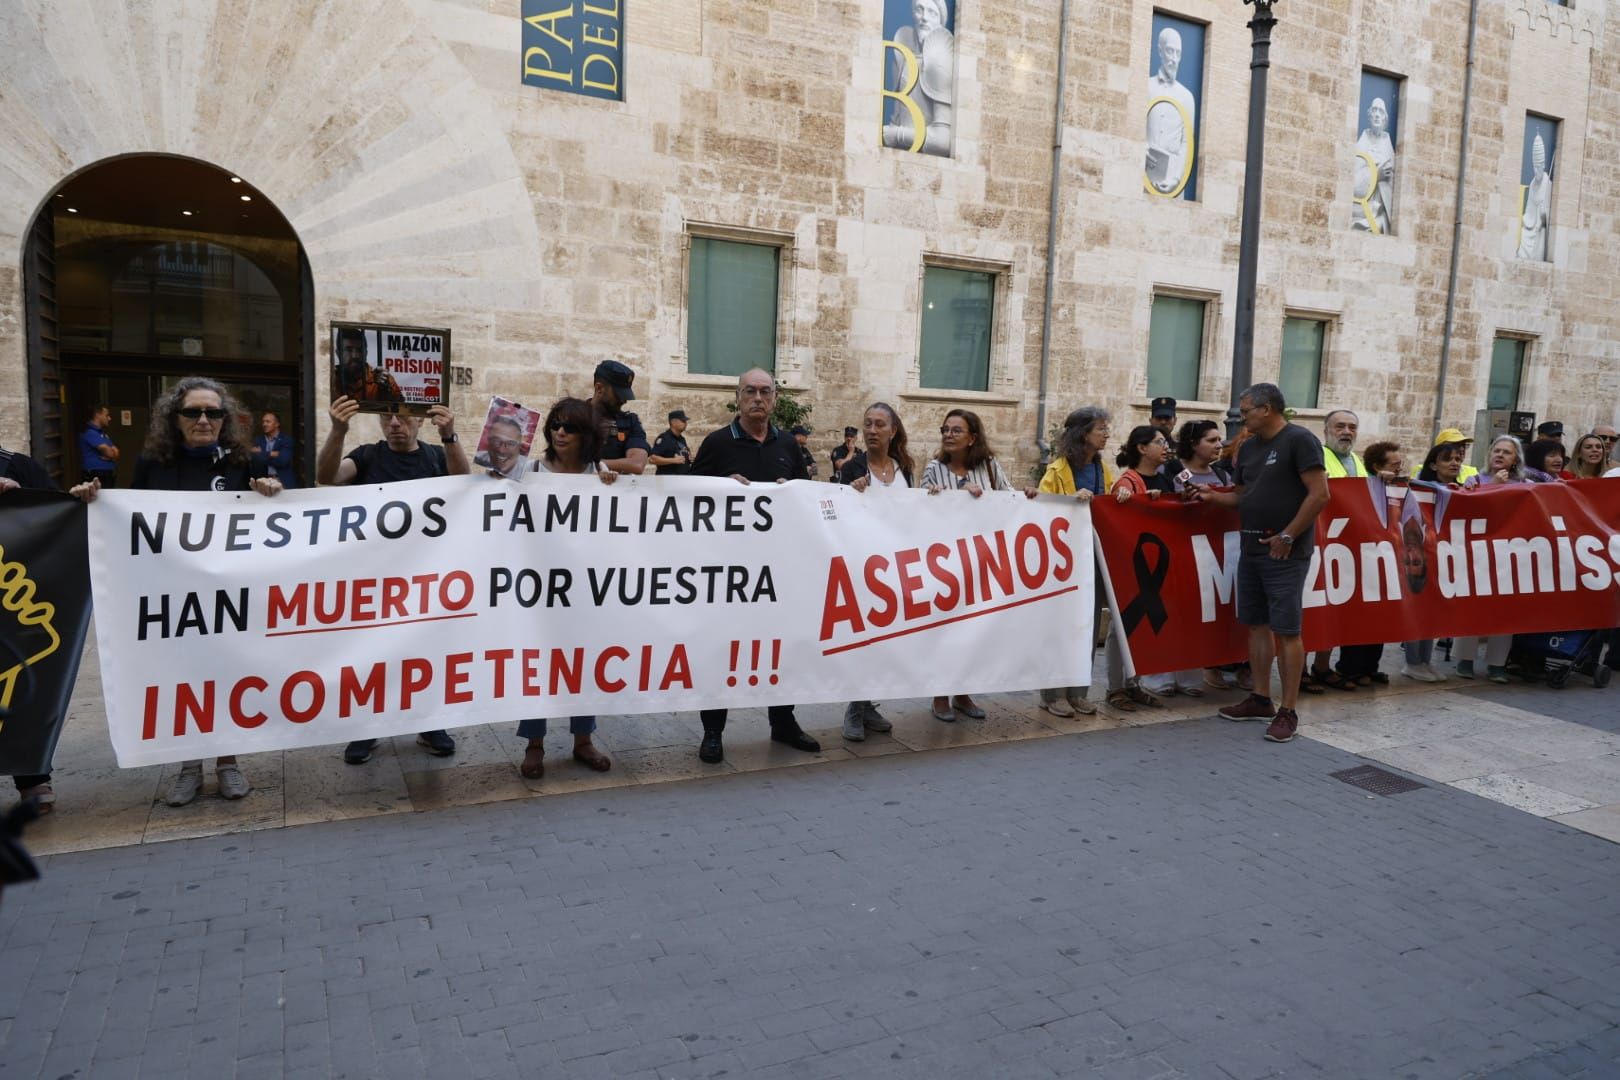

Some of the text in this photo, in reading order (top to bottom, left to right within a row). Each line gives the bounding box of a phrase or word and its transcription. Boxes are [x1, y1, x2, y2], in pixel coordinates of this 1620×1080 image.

[385, 357, 443, 375] PRISIÓN
[387, 334, 442, 353] MAZÓN
[130, 492, 774, 557] NUESTROS FAMILIARES
[137, 565, 777, 641] HAN MUERTO POR VUESTRA
[820, 516, 1075, 642] ASESINOS
[1190, 516, 1403, 624] Mzón
[143, 639, 782, 740] INCOMPETENCIA !!!
